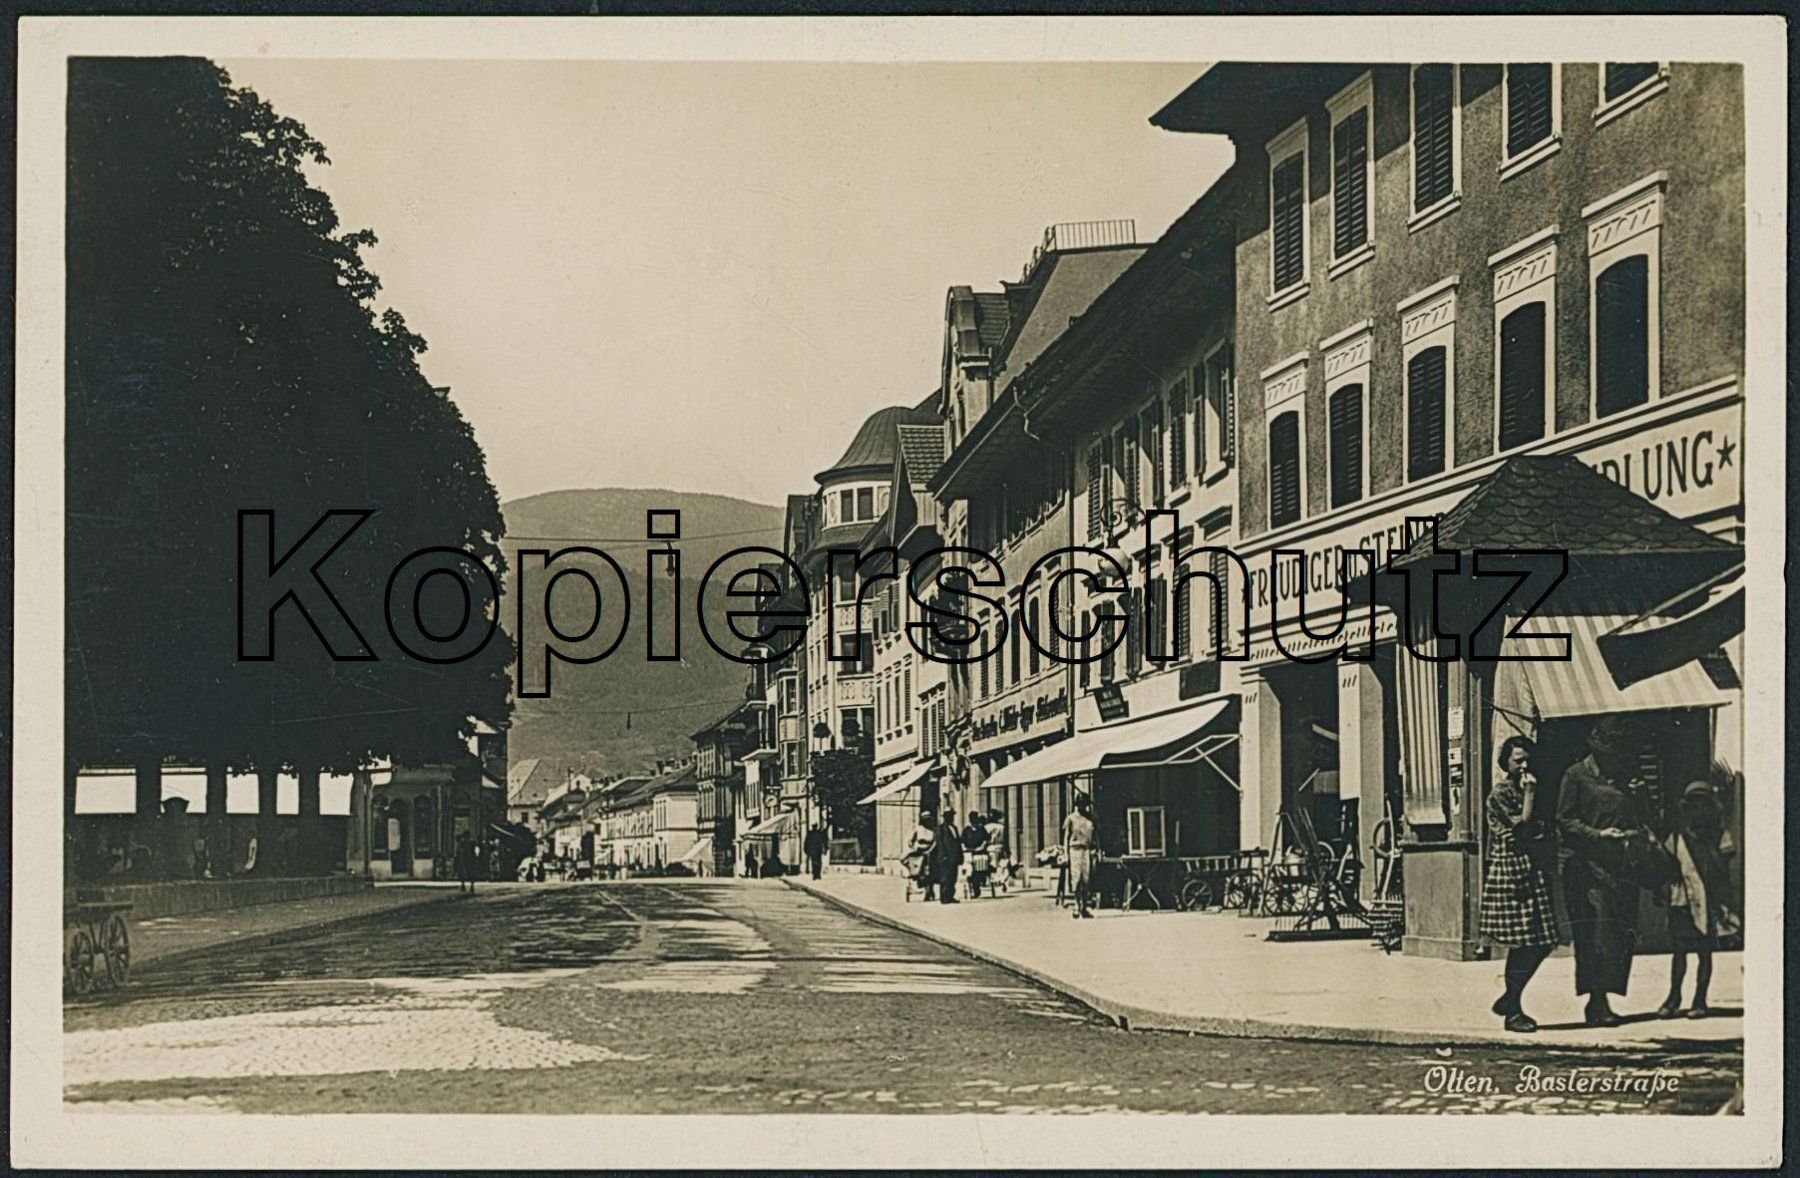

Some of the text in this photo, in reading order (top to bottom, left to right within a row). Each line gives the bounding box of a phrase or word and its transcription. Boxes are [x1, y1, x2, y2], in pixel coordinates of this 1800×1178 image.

[1249, 544, 1346, 610] FRUDIGER
[1359, 512, 1447, 577] STEIN
[1591, 430, 1713, 500] DLUNG
